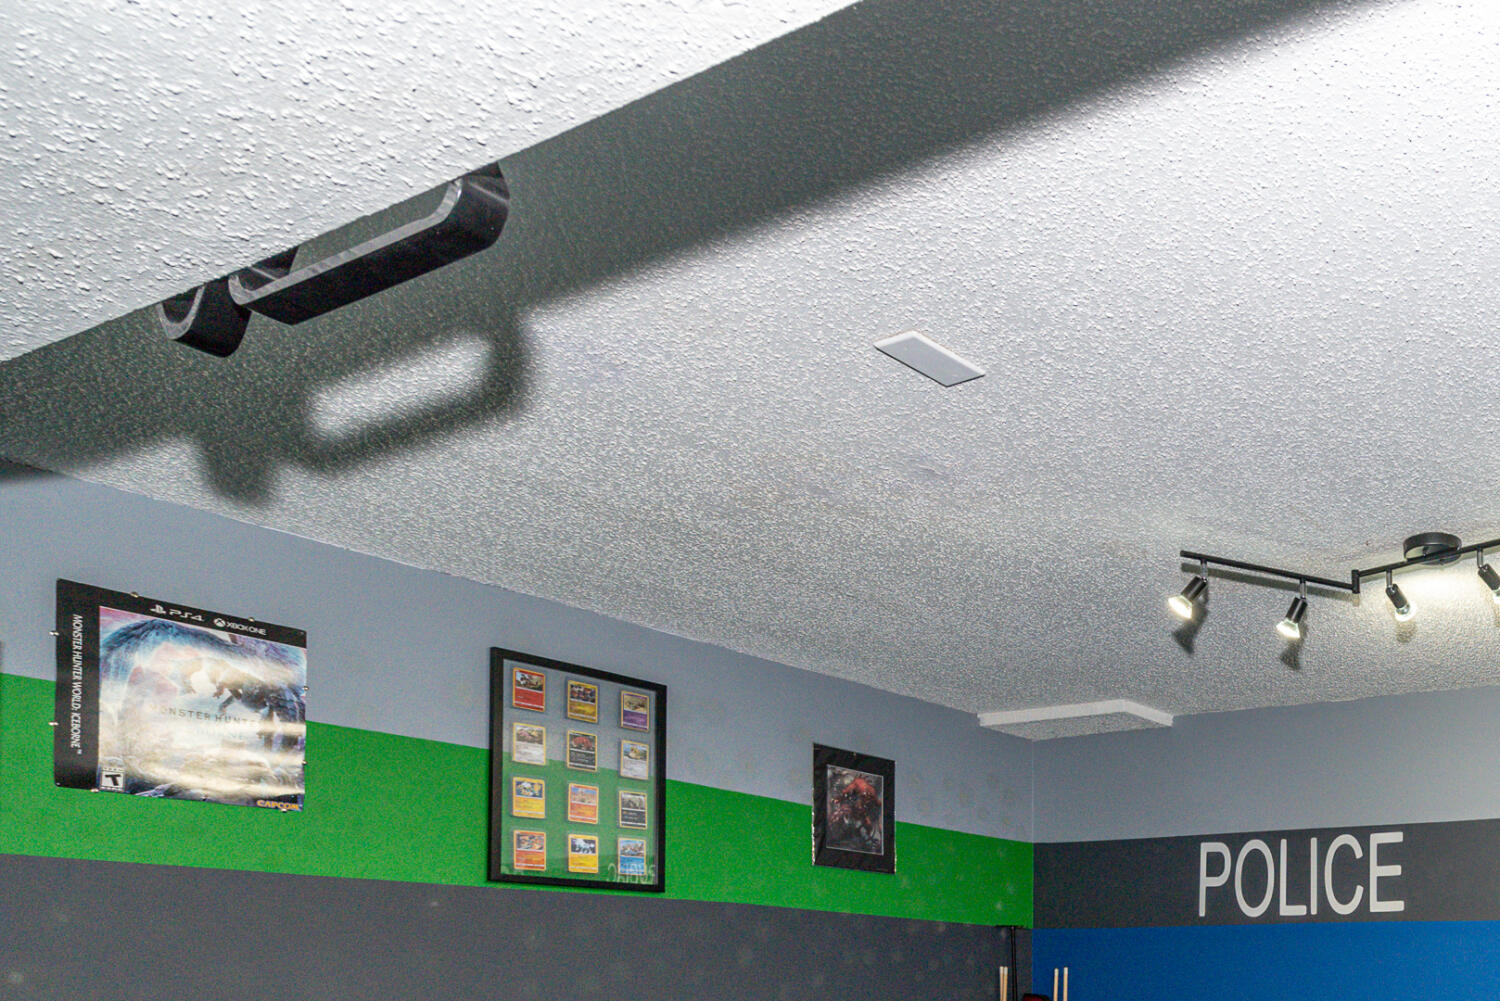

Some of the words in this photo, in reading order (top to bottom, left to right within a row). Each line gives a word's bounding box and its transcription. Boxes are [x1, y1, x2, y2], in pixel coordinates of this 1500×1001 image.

[169, 608, 205, 622] PS4
[72, 614, 83, 651] MONSTER
[249, 626, 267, 635] ONE
[72, 652, 83, 681] HUNTER
[105, 774, 121, 786] T
[256, 799, 299, 810] CAPCOM
[1198, 831, 1405, 918] POLICE
